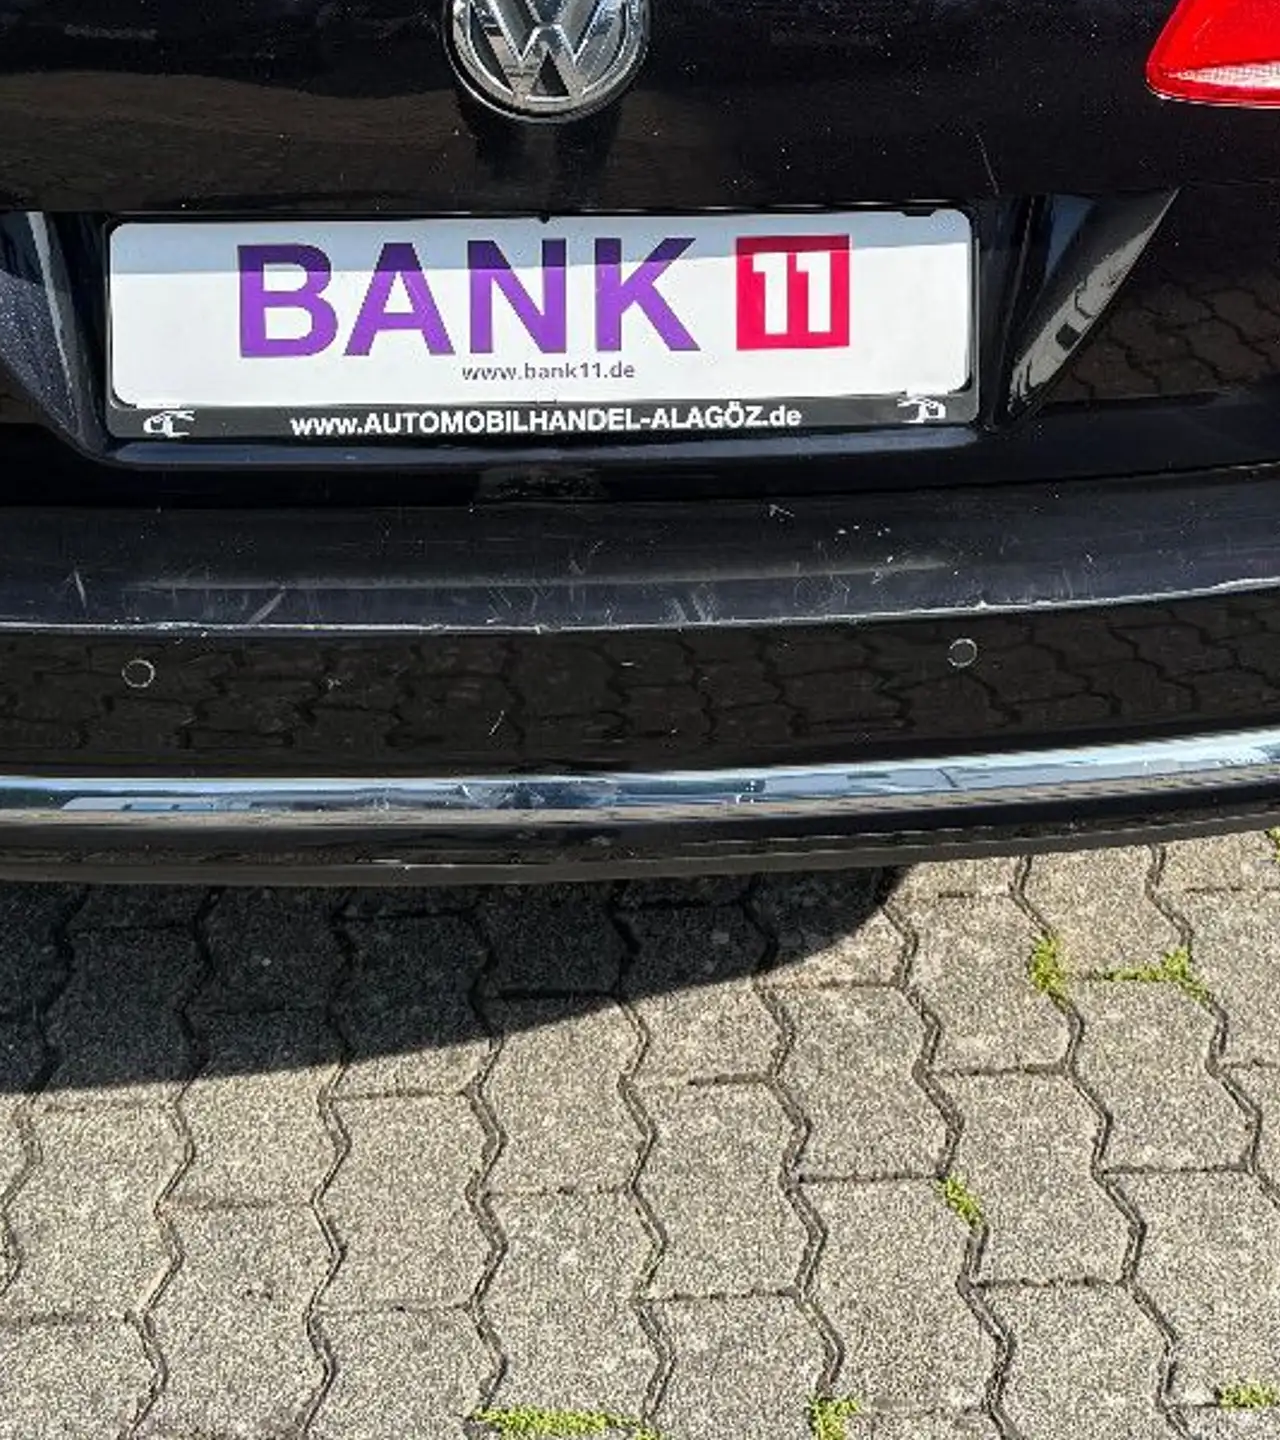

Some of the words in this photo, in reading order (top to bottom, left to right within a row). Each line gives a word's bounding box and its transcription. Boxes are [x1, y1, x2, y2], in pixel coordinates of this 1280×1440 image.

[237, 237, 701, 358] BANK
[751, 246, 834, 338] 11
[461, 361, 636, 381] www.bank11.de
[289, 400, 803, 437] www.AUTOMOBILHANDEL-ALAGÖZ.de
